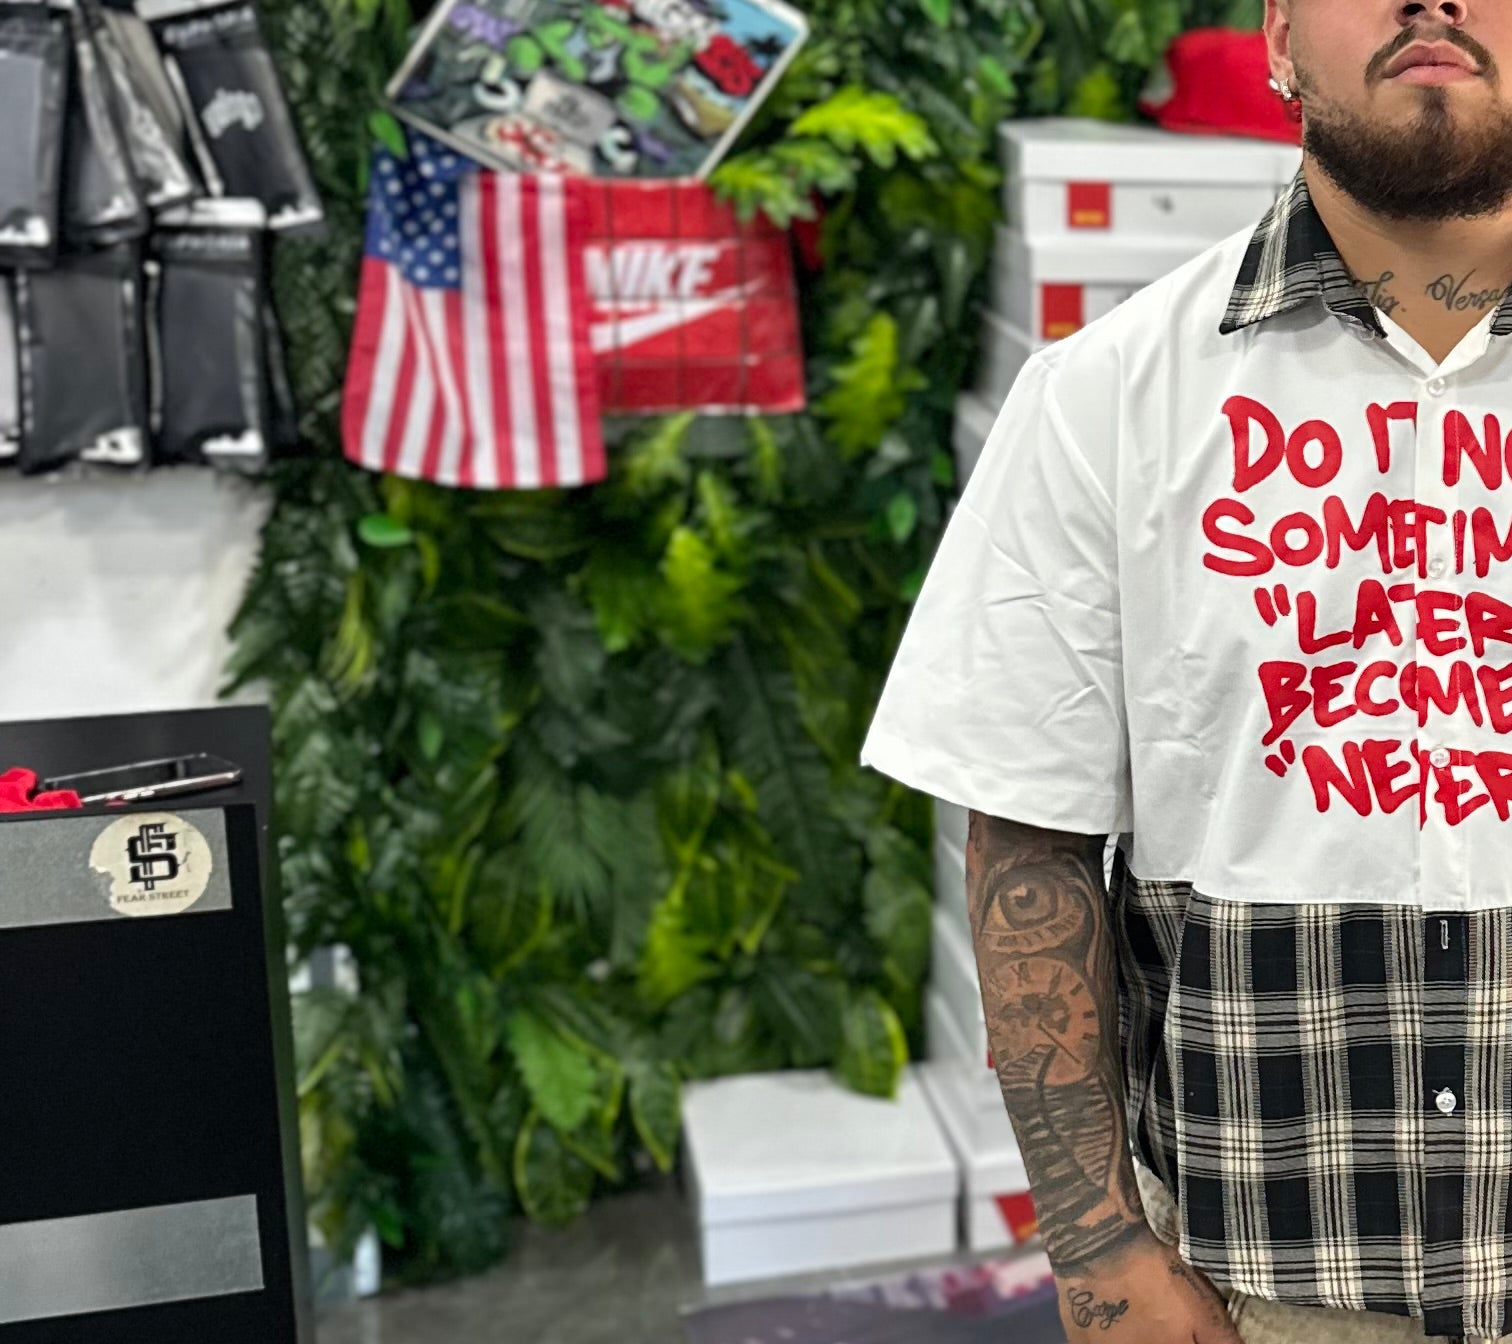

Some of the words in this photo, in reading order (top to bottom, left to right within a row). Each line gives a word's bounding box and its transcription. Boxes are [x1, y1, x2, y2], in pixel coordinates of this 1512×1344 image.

[583, 241, 722, 302] NIKE
[117, 892, 146, 905] FEAR
[150, 888, 190, 903] STREET
